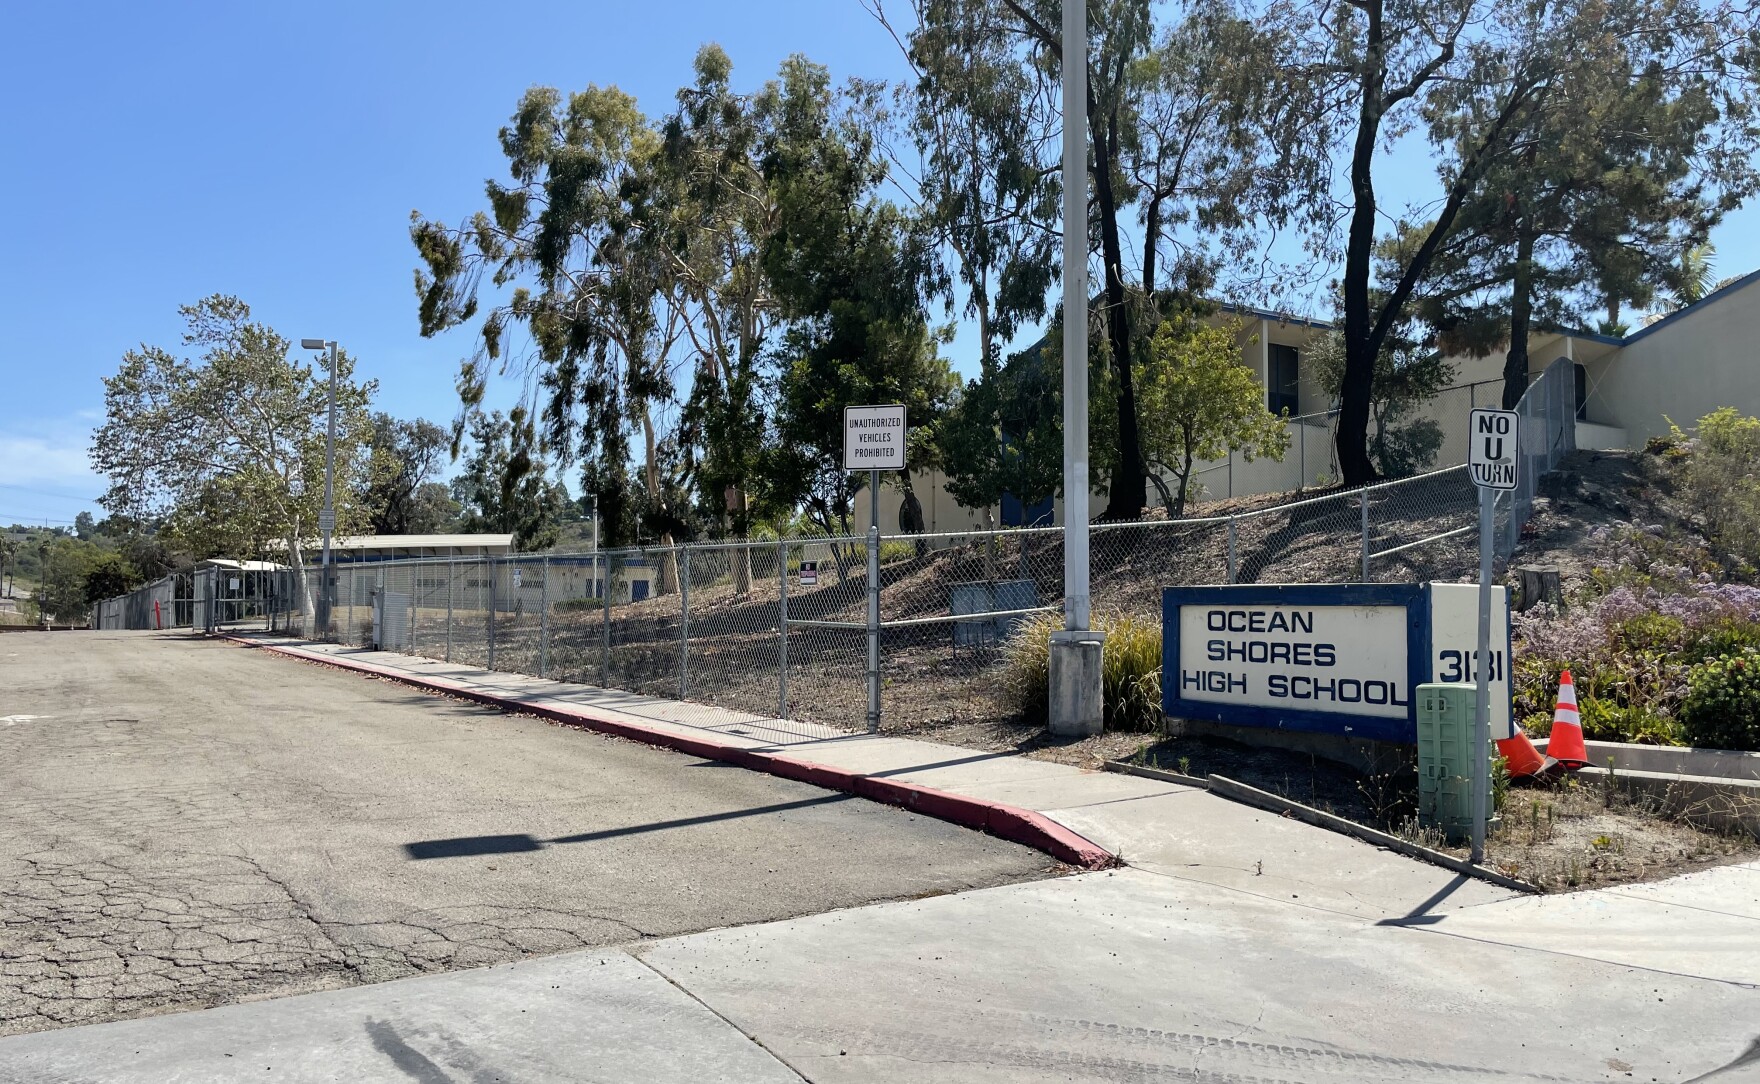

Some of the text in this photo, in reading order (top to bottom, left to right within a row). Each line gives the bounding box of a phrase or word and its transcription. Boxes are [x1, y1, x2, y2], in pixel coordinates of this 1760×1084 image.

[849, 418, 900, 428] UNAUTHORIZED
[1479, 415, 1509, 434] NO
[859, 433, 891, 442] VEHICLES
[855, 448, 894, 457] PROHIBITED
[1485, 437, 1502, 460] U
[1472, 463, 1514, 483] TURN
[1207, 610, 1313, 633] OCEAN
[1207, 639, 1336, 667] SHORES
[1439, 649, 1503, 683] 3131
[1182, 669, 1408, 707] HIGH SCHOOL
